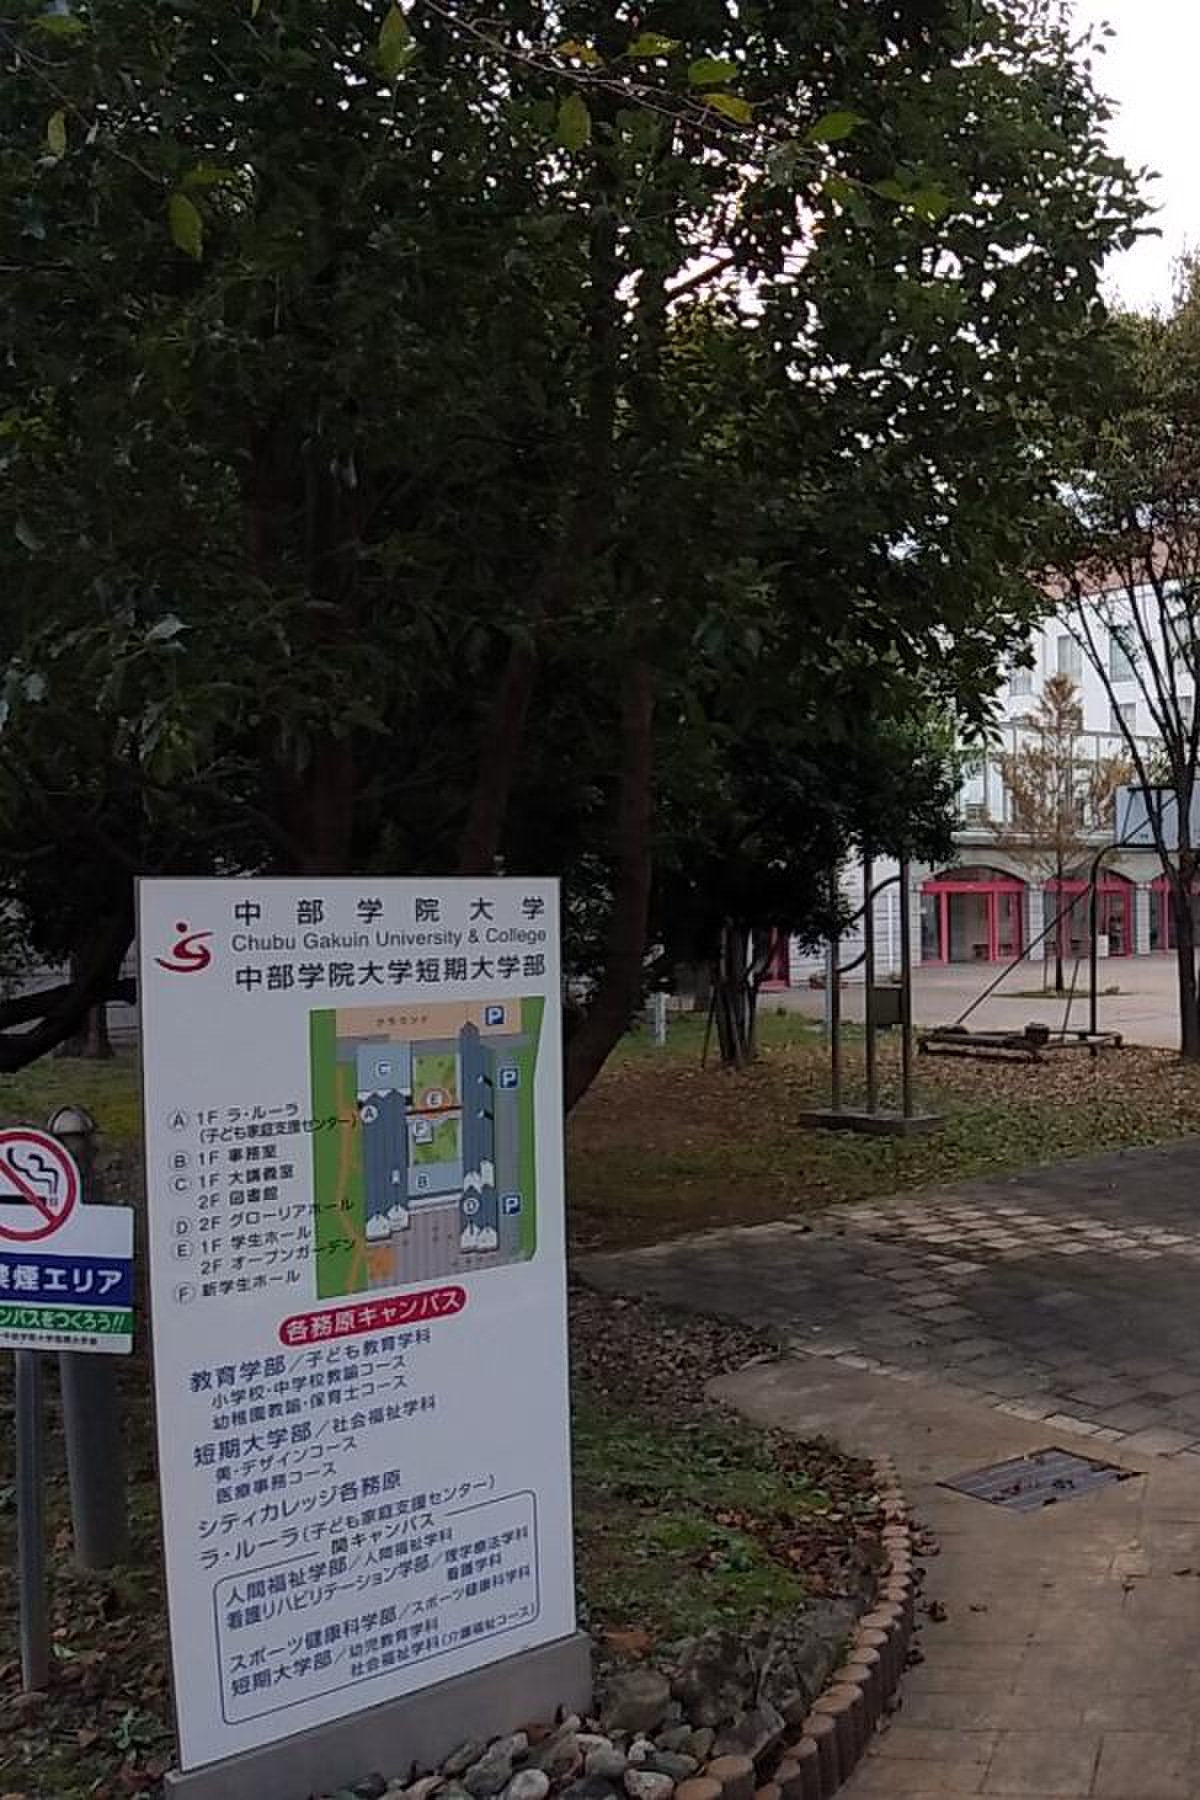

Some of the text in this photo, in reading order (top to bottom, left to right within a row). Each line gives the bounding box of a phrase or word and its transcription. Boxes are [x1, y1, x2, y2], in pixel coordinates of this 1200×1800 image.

[234, 897, 545, 926] 中部学院大学
[232, 927, 547, 952] Chubu Gakuin University & College
[235, 954, 545, 991] 中部学院大学短期大学部
[198, 1110, 219, 1125] 1F
[227, 1103, 298, 1122] ラ・ルーラ
[199, 1151, 220, 1166] 1F
[228, 1144, 277, 1162] 事務室
[200, 1173, 221, 1188] 1F
[198, 1186, 278, 1210] 2F 図書館
[199, 1215, 221, 1231] 2F
[230, 1199, 354, 1229] グローリアホール
[202, 1238, 222, 1254] 1F
[230, 1226, 312, 1250] 学生ホール
[201, 1239, 355, 1275] 2F オープンガーデン
[202, 1270, 300, 1297] 新学生ホール
[286, 1292, 461, 1343] 各務原キャンパス
[216, 1462, 336, 1504] 医療事務コース
[198, 1469, 401, 1538] シティカレッジ各務原
[331, 1512, 434, 1555] 関キャンパス
